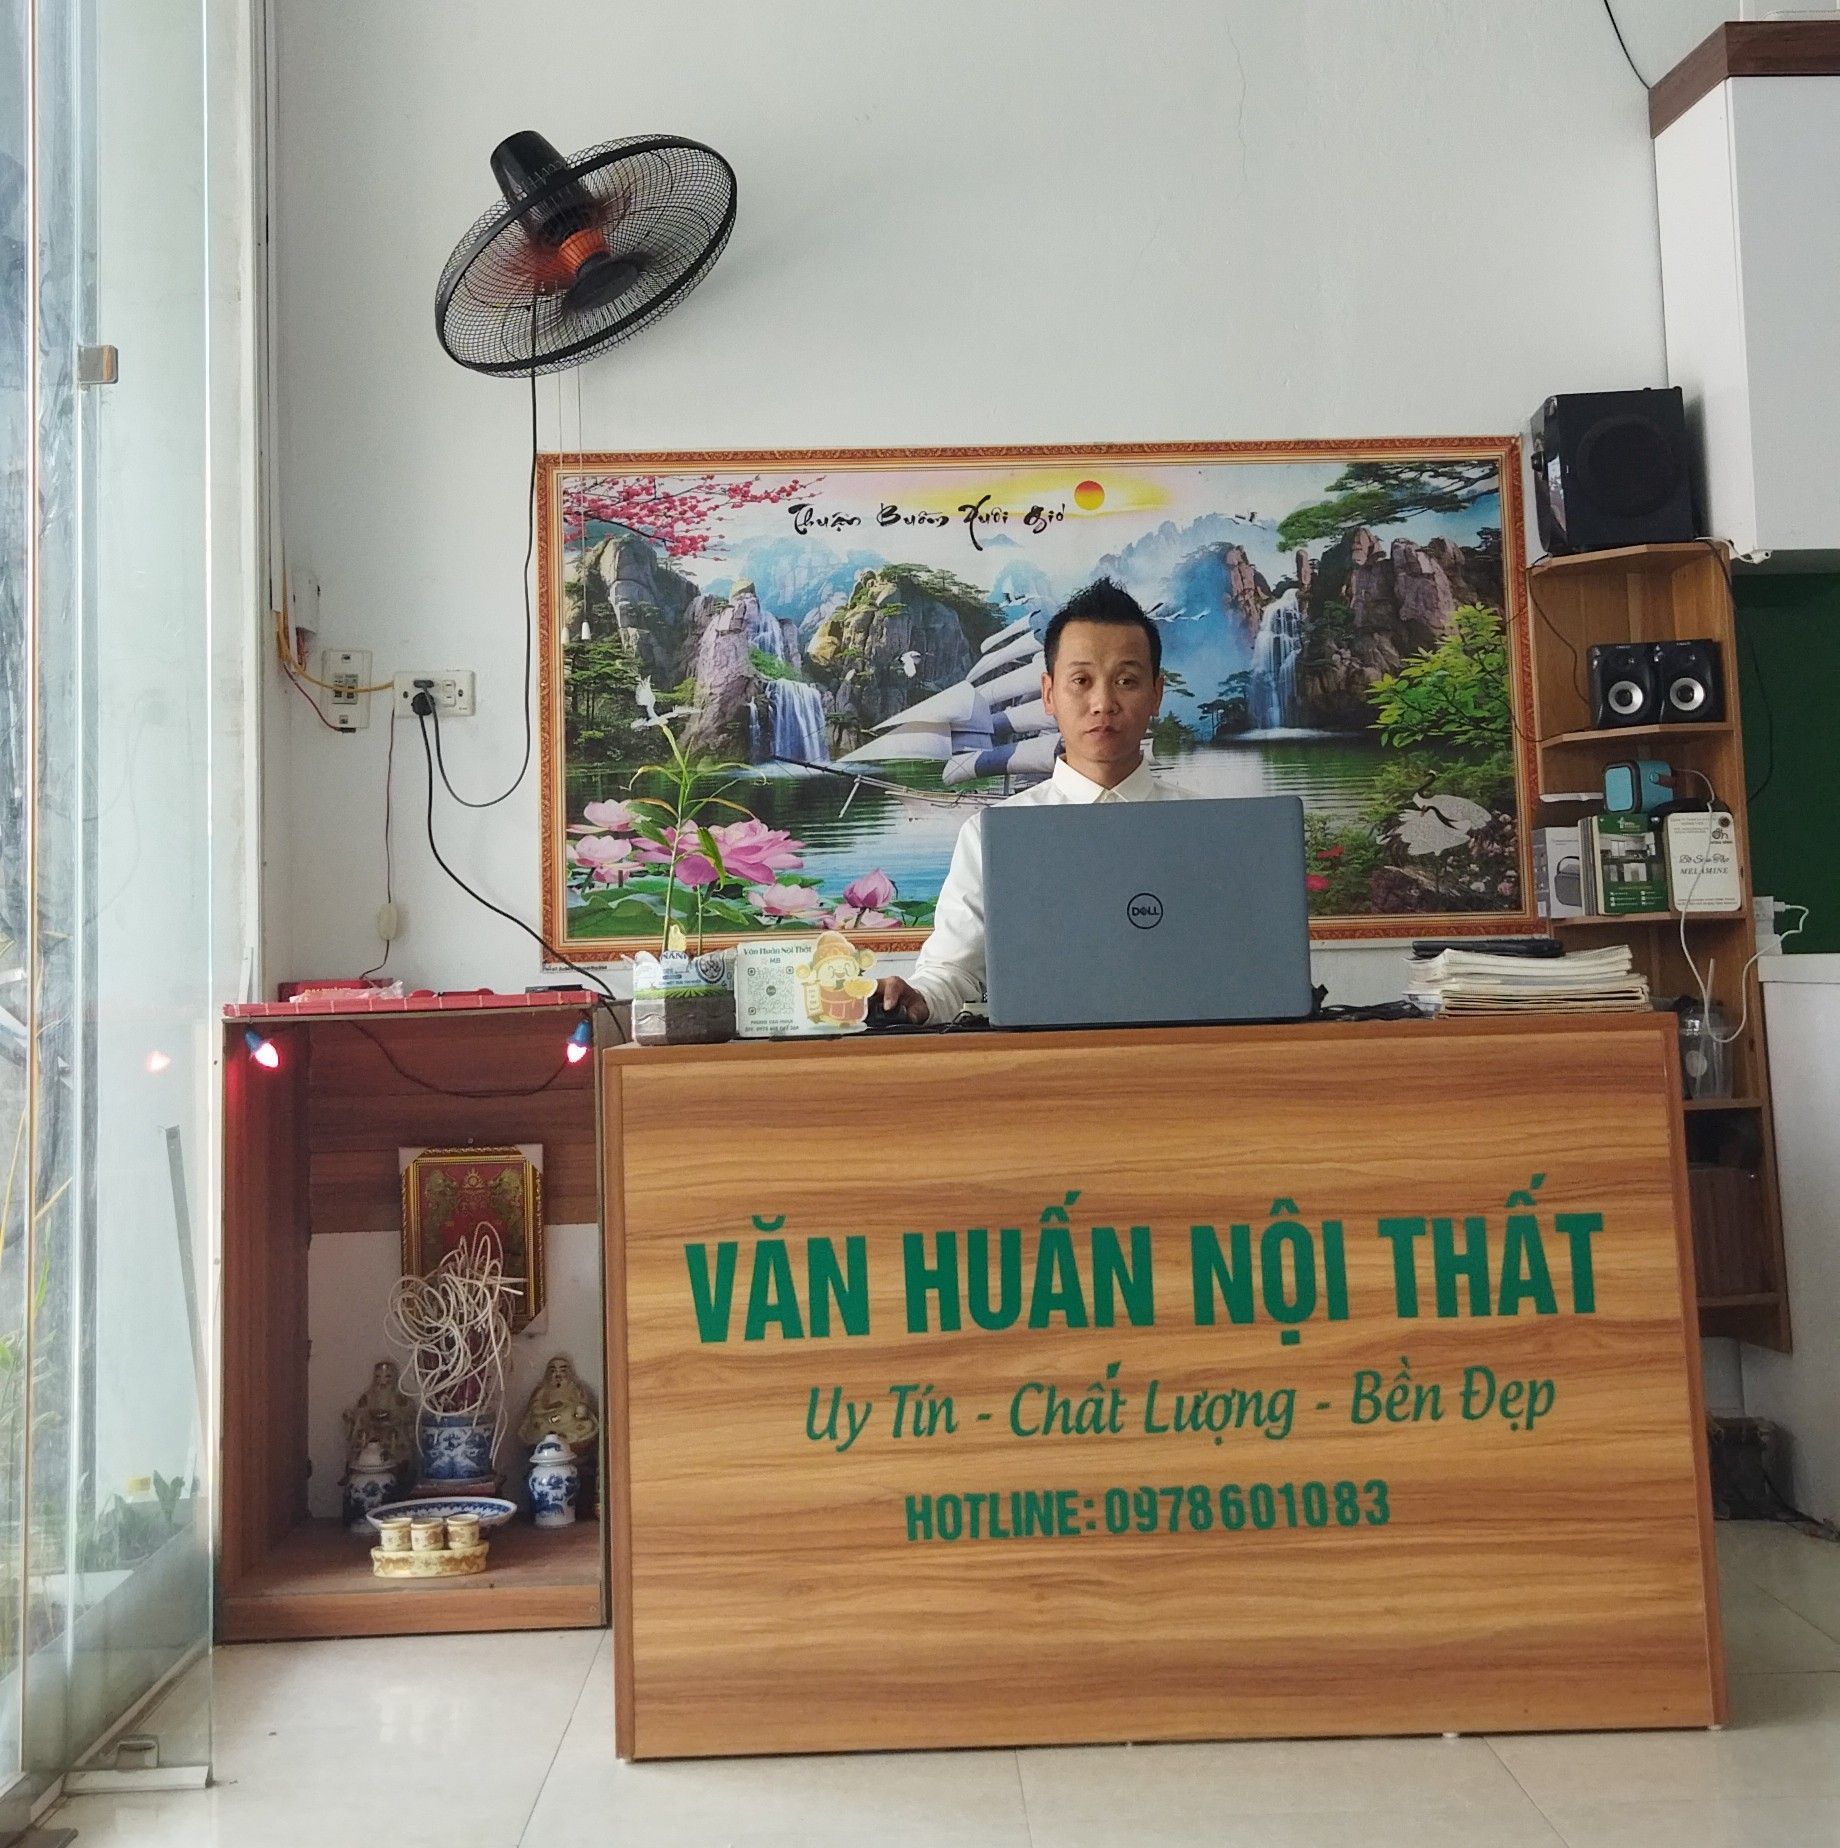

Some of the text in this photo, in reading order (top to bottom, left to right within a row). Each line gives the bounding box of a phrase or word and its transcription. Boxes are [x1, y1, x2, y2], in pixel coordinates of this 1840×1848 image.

[788, 503, 862, 535] Thuận
[958, 494, 1009, 551] Xuôi
[1023, 503, 1065, 534] Gió
[1131, 906, 1160, 916] DELL
[685, 1174, 1603, 1345] VĂN HUẤN NỘI THẤT
[806, 1386, 872, 1453] Uy
[890, 1383, 958, 1439] Tín
[1010, 1361, 1126, 1437] Chất
[1144, 1379, 1297, 1446] Lượng
[1350, 1355, 1445, 1425] Bền
[1459, 1364, 1556, 1432] Đẹp
